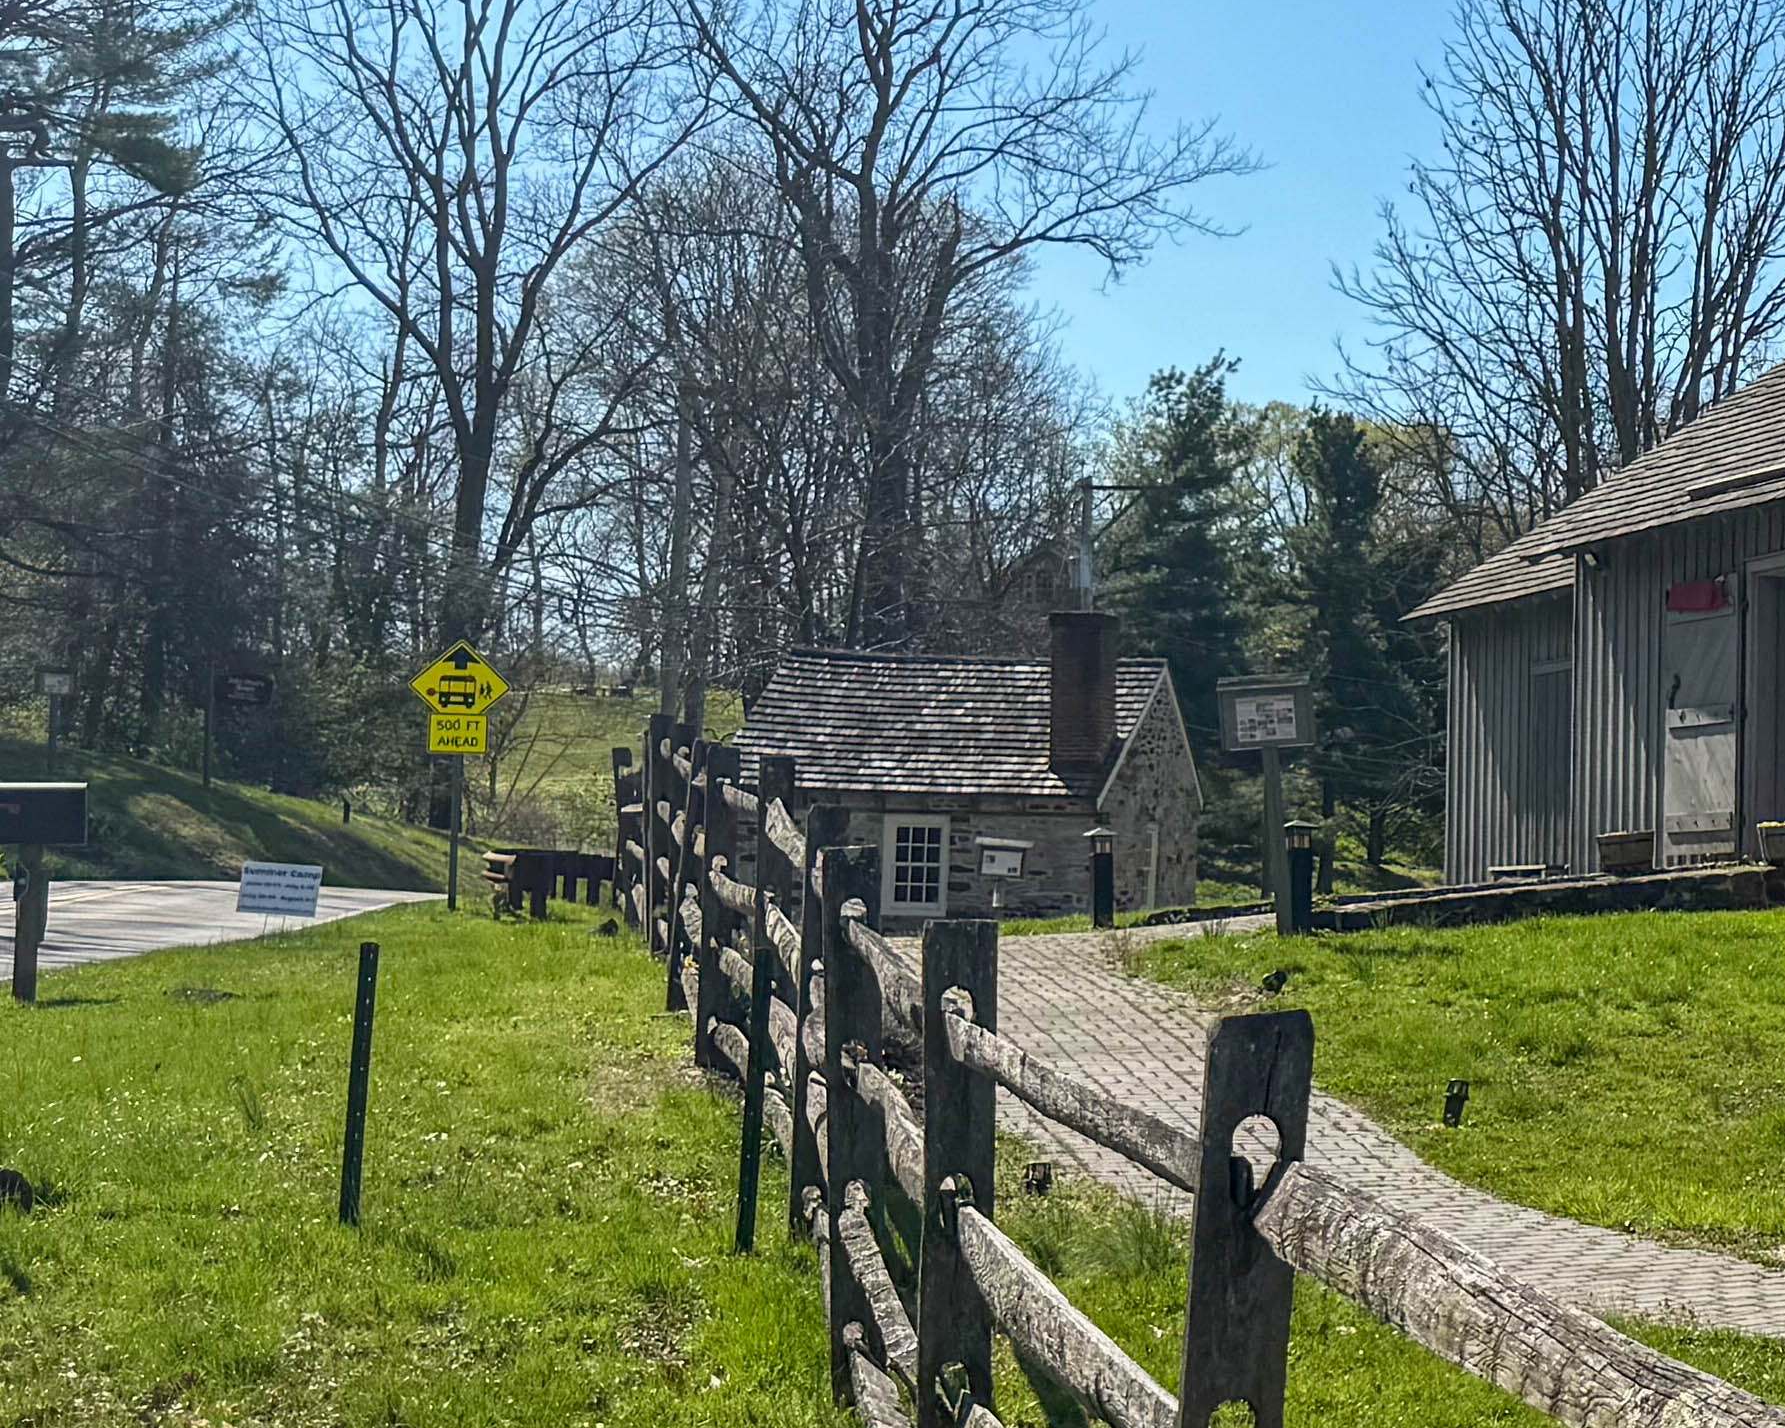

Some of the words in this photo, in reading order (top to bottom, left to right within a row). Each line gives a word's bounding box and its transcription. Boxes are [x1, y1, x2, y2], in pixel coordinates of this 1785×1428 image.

[436, 719, 461, 731] 500
[466, 721, 480, 731] FT
[437, 736, 478, 748] AHEAD
